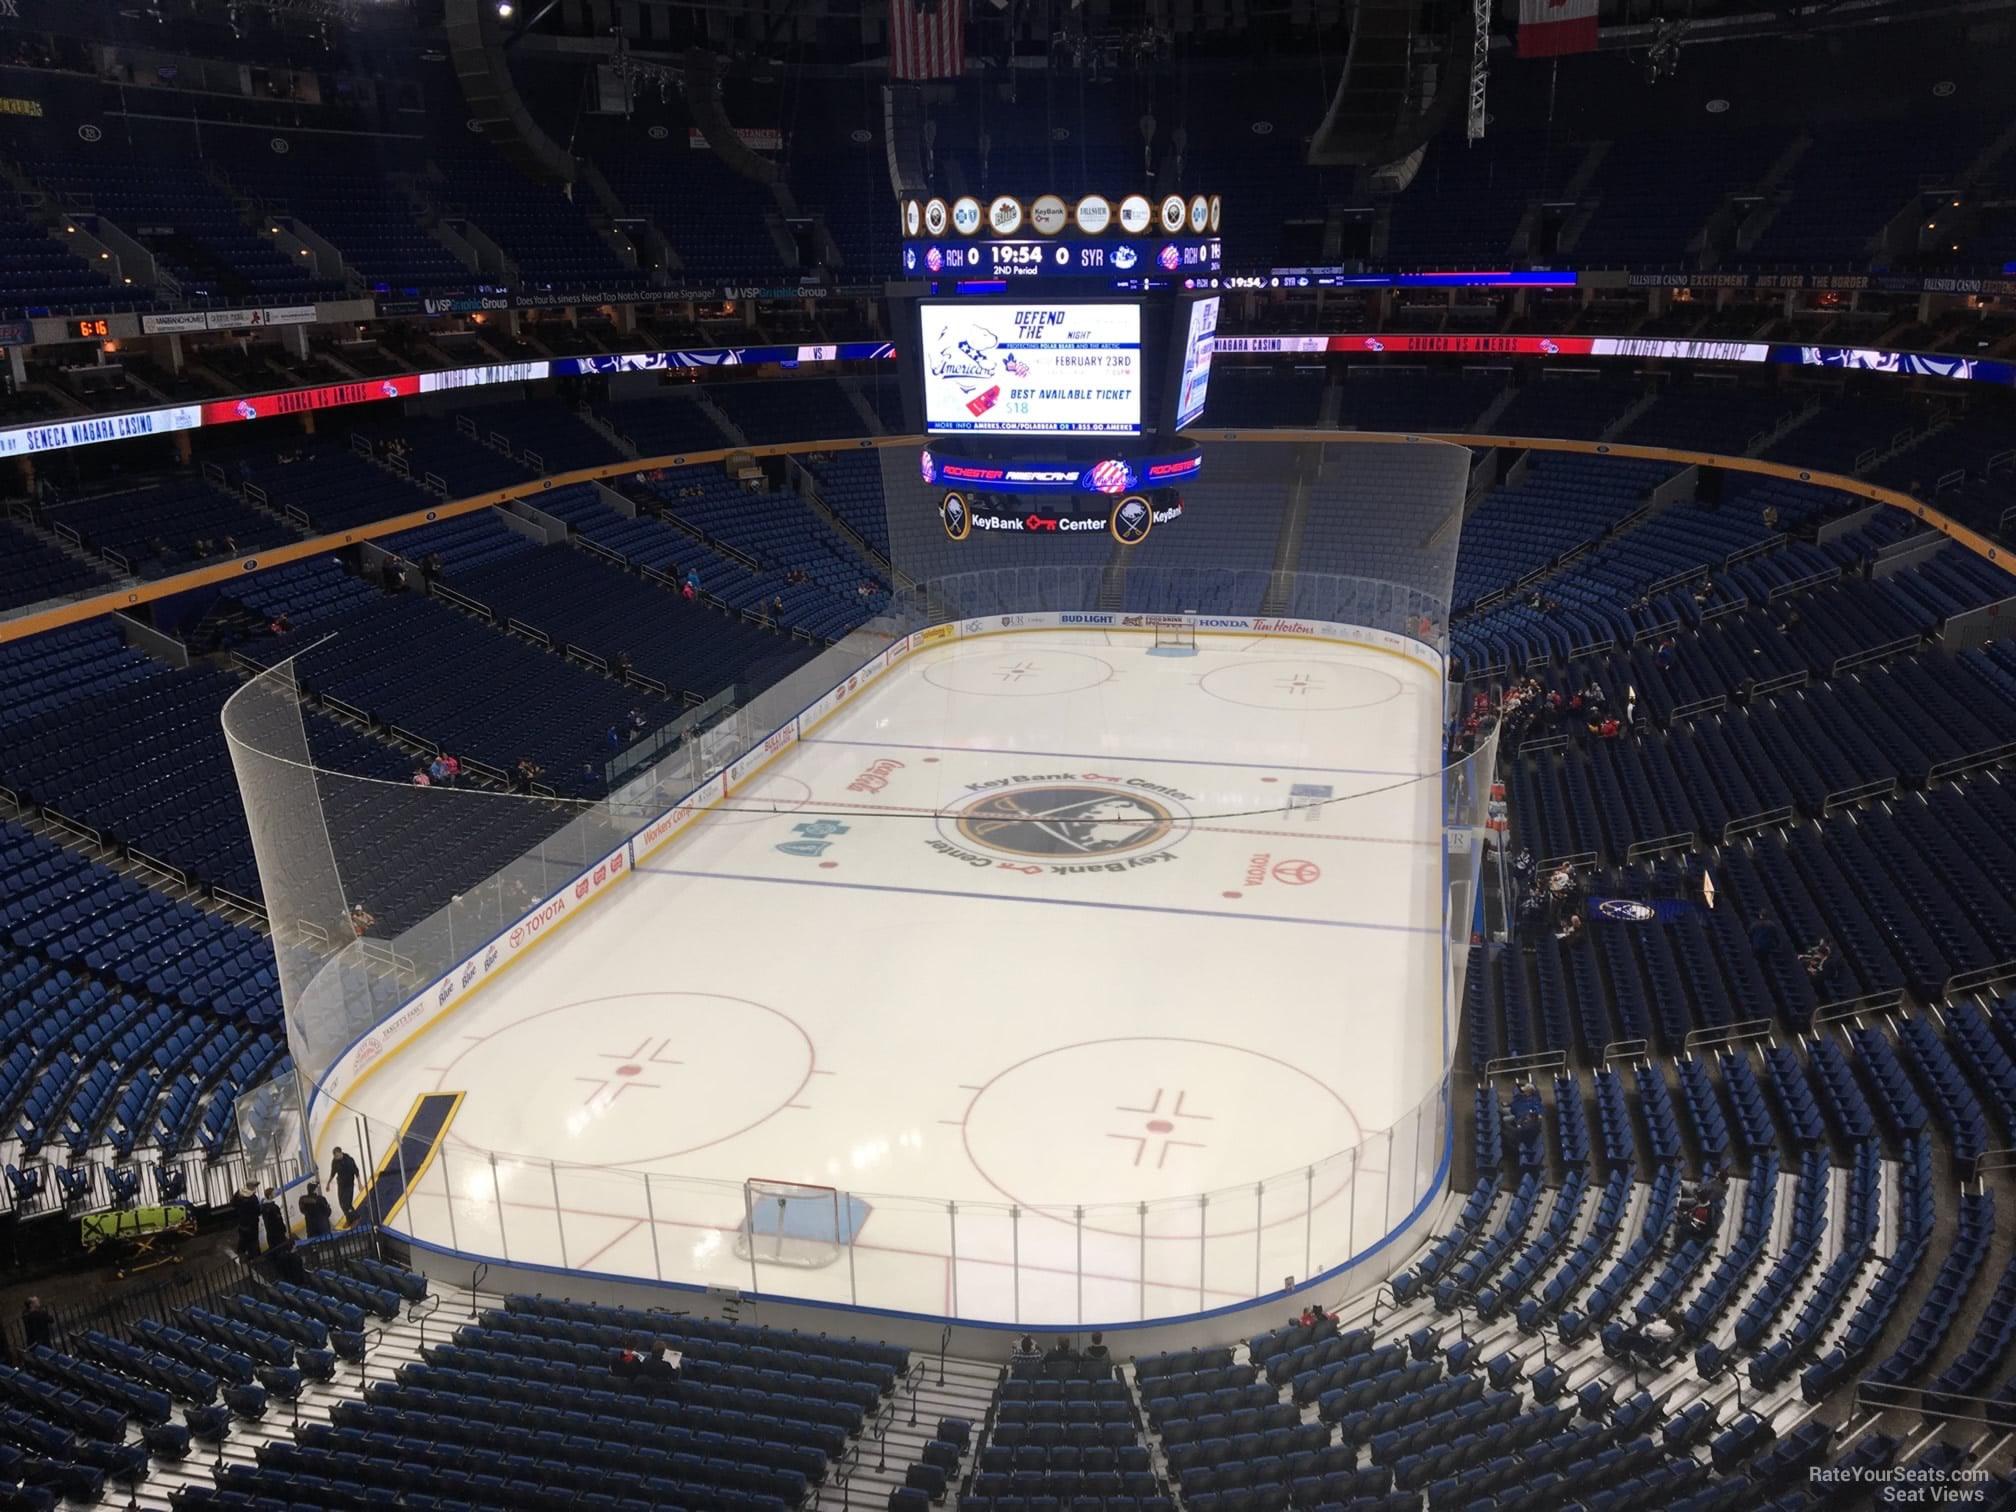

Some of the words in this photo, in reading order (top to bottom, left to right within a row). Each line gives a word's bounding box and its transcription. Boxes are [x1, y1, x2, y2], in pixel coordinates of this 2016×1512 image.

[1035, 208, 1063, 218] KeyBank
[947, 249, 964, 266] RCH
[968, 247, 979, 265] 0
[992, 246, 1043, 263] 19:54
[1056, 247, 1069, 264] 0
[1081, 249, 1104, 267] SYR
[1184, 247, 1198, 265] RCH
[1200, 245, 1207, 262] 0
[994, 266, 1012, 275] 2ND
[1014, 266, 1038, 275] Period
[1210, 278, 1219, 288] 0
[1231, 277, 1261, 288] 19:54
[1271, 277, 1279, 287] 0
[1284, 277, 1296, 286] SYR
[1690, 274, 1748, 287] EXCITEMENT
[1756, 275, 1779, 287] JUST
[1780, 275, 1803, 287] OVER
[1812, 276, 1828, 288] THE
[1831, 276, 1869, 288] BORDER
[1957, 279, 1982, 292] CASINO
[516, 295, 534, 305] Does
[534, 294, 549, 304] Your
[582, 292, 602, 302] Need
[603, 292, 616, 304] Top
[617, 290, 639, 301] Notch
[681, 288, 716, 300] Signage?
[1014, 311, 1066, 326] DEFEND
[80, 319, 108, 337] 6:16
[1018, 326, 1044, 339] THE
[1067, 331, 1092, 339] NIGHT
[813, 347, 823, 358] VS
[1214, 340, 1248, 351] NIAGARA
[1252, 340, 1282, 351] CASINO
[1456, 339, 1468, 351] VS
[1055, 356, 1102, 366] FEBRUARY
[1106, 356, 1132, 366] 23RD
[317, 389, 329, 407] VS
[1010, 389, 1036, 400] BEST
[1038, 389, 1093, 400] AVAILABLE
[1096, 389, 1133, 400] TICKET
[1006, 402, 1029, 414] $18
[27, 425, 68, 450] SENECA
[73, 420, 115, 444] NIAGARA
[119, 415, 153, 438] CASINO
[973, 422, 1058, 430] AMERKS.COM/POLARBEAR
[1072, 423, 1133, 431] 1.855.GO.AMERKS
[944, 465, 1003, 480] ROCHESTER
[1005, 471, 1080, 482] AMERICANS
[1149, 459, 1196, 475] ROCHESTER
[1153, 504, 1183, 524] KeyBank
[971, 514, 1024, 532] KeyBank
[1059, 518, 1107, 531] Center
[1010, 615, 1024, 626] UR
[1061, 615, 1083, 624] BUD
[1084, 615, 1113, 625] LIGHT
[1199, 619, 1249, 629] HONDA
[1252, 618, 1272, 633] Tim
[1273, 619, 1315, 635] Hortons
[764, 732, 782, 752] BULLY
[964, 772, 1078, 793] KeyBank
[1125, 778, 1196, 803] Center
[924, 838, 993, 869] Center
[1050, 850, 1180, 876] KeyBank
[1243, 853, 1271, 887] TOYOTA
[526, 897, 567, 936] TOYOTA
[462, 965, 477, 990] Blue
[438, 983, 455, 1007] Blue
